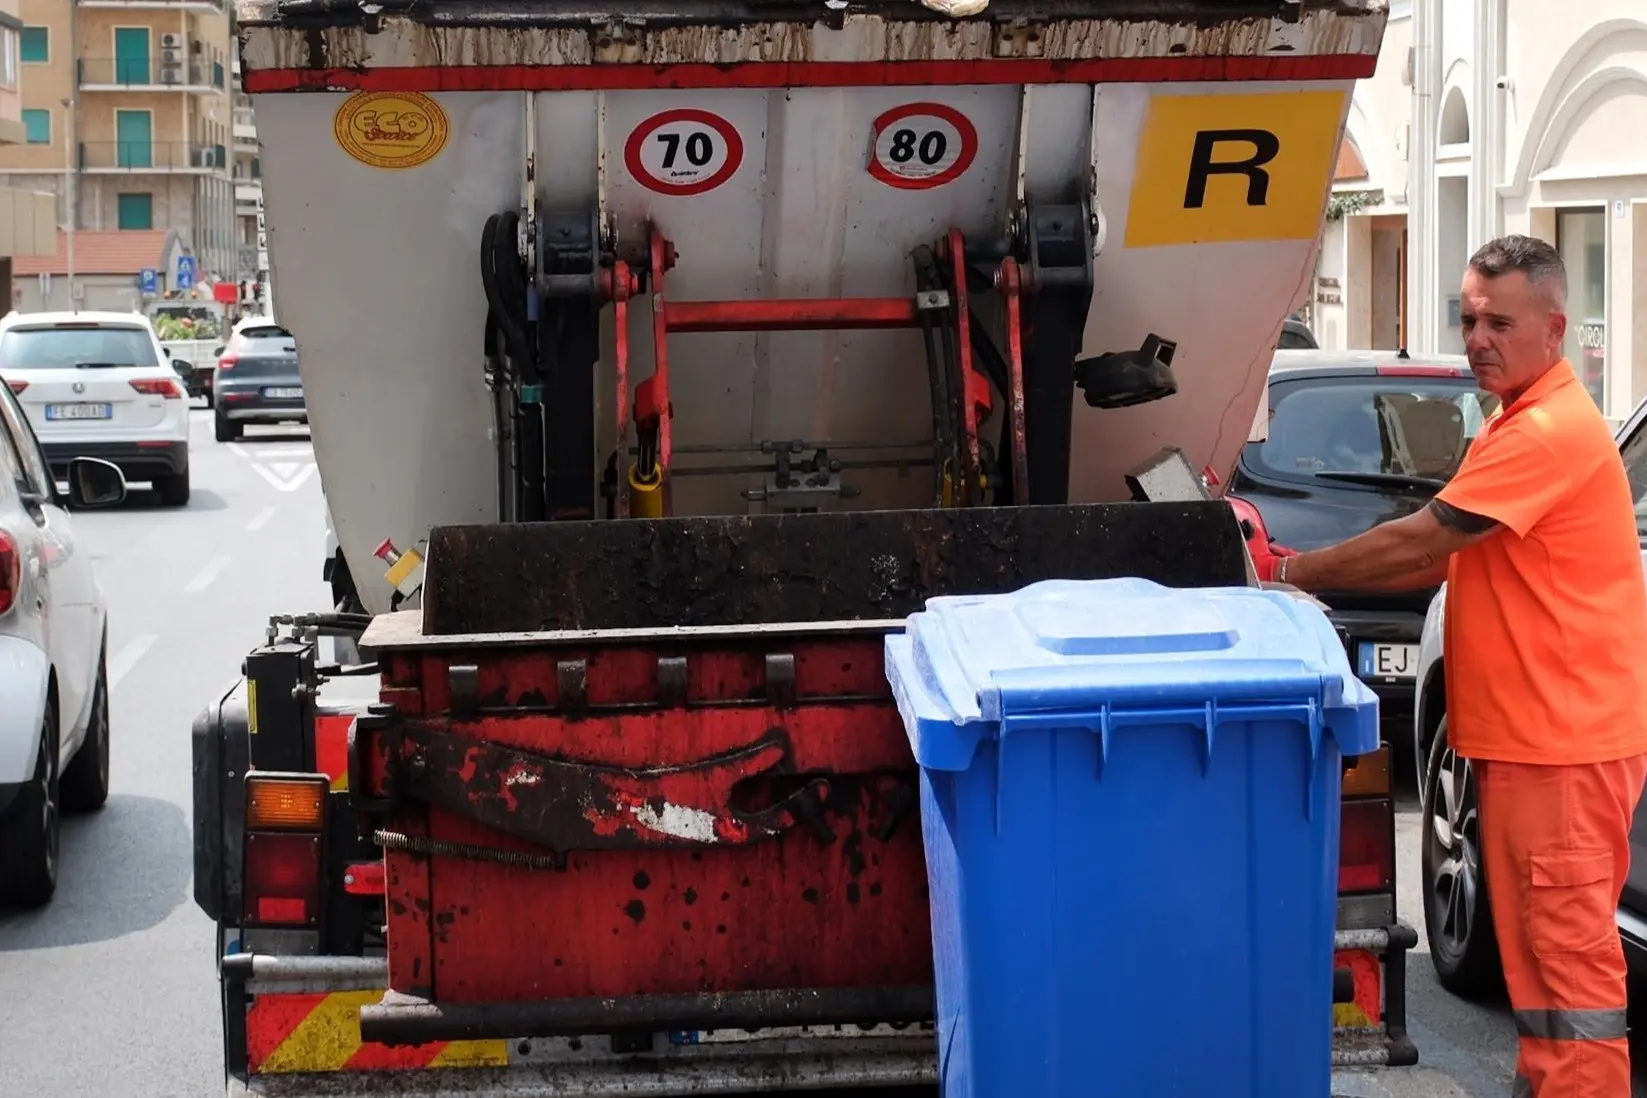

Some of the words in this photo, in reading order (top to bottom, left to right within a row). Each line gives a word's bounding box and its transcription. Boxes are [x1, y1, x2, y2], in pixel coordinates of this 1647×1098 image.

[354, 110, 429, 137] ECO
[657, 132, 713, 168] 70
[889, 129, 947, 165] 80
[1183, 128, 1280, 209] R
[1379, 647, 1407, 673] EJ
